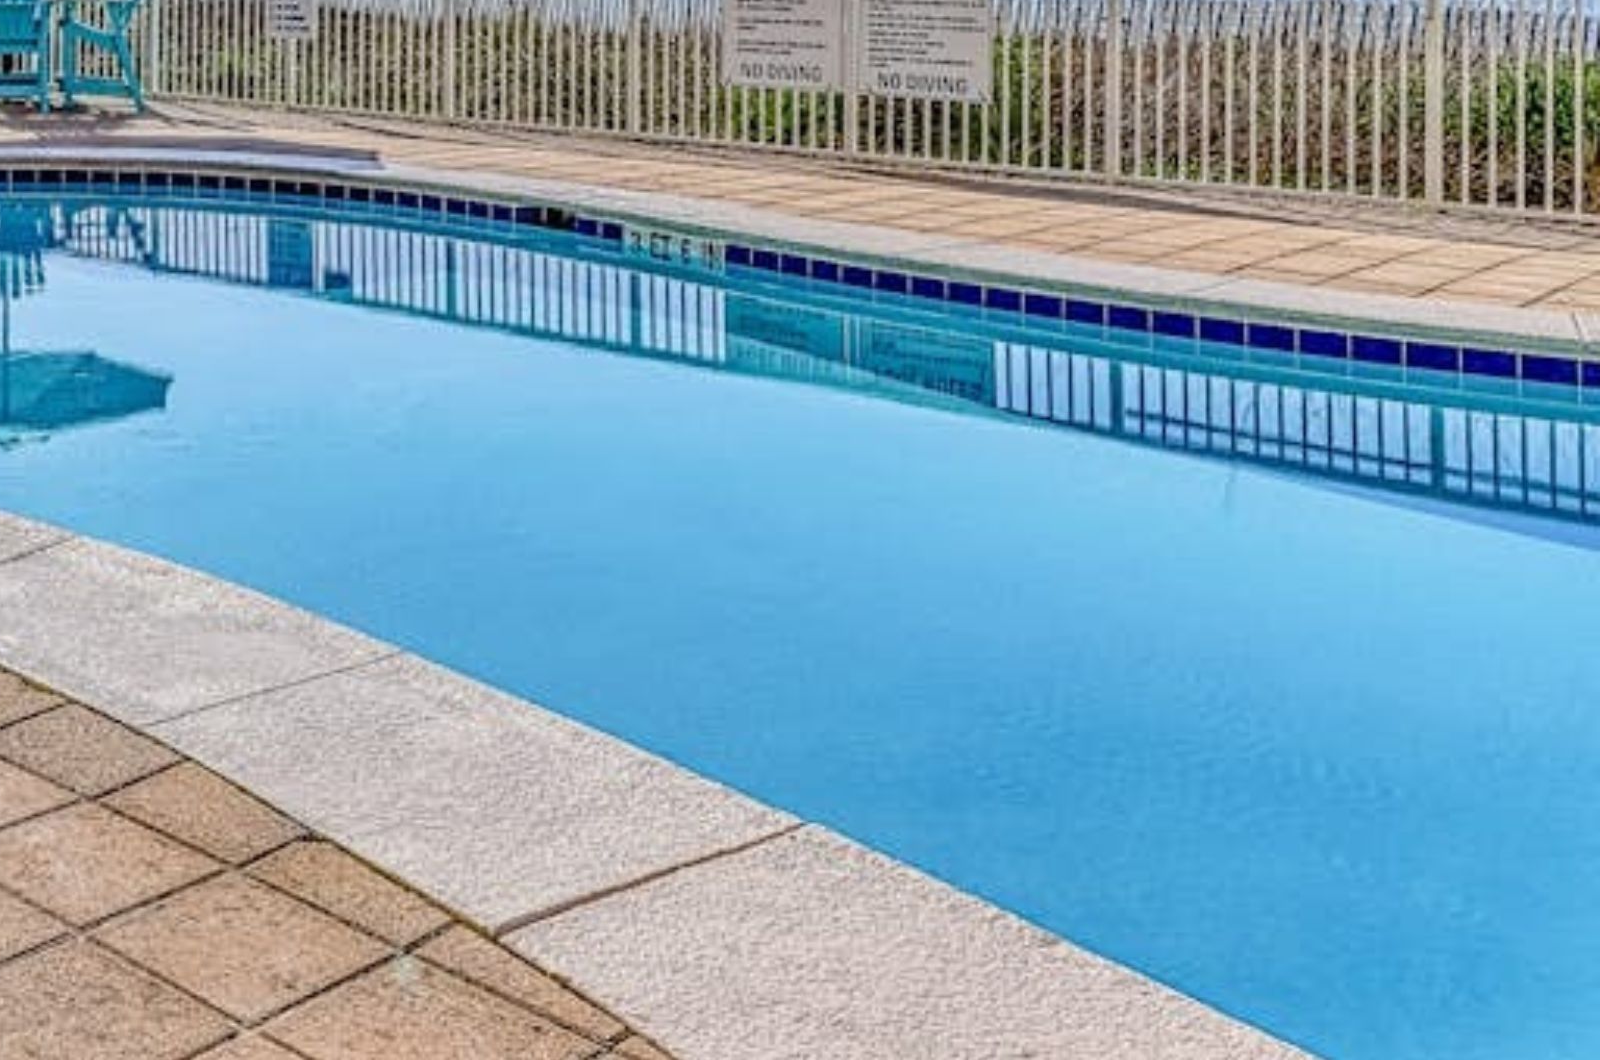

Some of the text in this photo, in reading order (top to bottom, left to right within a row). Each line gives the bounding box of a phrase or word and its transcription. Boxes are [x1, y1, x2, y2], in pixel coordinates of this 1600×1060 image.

[740, 62, 822, 82] NO DIVING
[878, 71, 969, 94] NO DIVING
